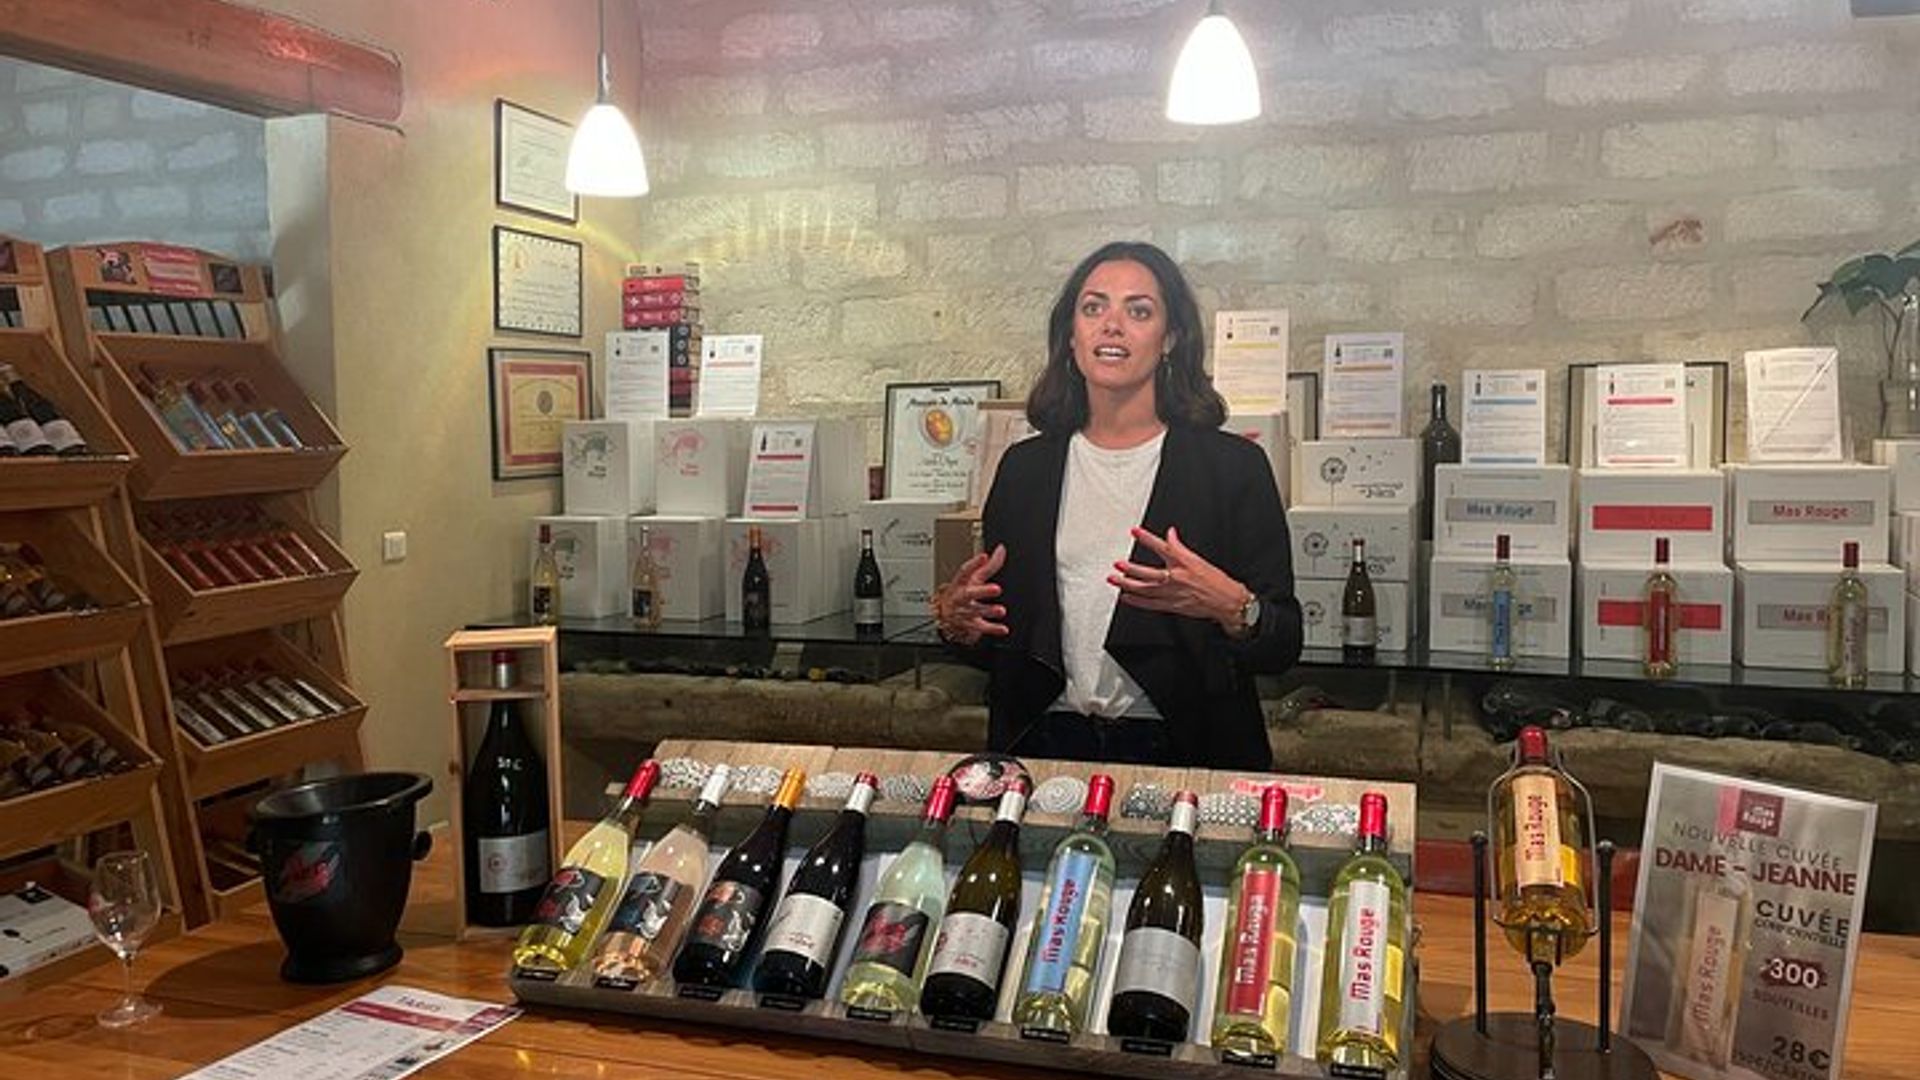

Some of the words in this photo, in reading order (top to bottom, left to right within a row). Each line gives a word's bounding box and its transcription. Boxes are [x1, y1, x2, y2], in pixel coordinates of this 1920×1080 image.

[1773, 505, 1801, 517] Mas
[1805, 505, 1849, 520] Rouge
[1673, 821, 1769, 856] NOUVELLE
[1776, 842, 1842, 871] CUVÉE
[1655, 847, 1727, 877] DAME
[1753, 862, 1857, 896] JEANNE
[1050, 877, 1079, 926] Rouge
[1239, 894, 1268, 946] Rouge
[1756, 900, 1849, 938] CUVÉE
[1041, 926, 1065, 963] Mas
[1352, 907, 1380, 959] Rouge
[1235, 946, 1259, 984] Mas
[1350, 962, 1372, 1000] Mas
[1770, 958, 1819, 989] 300
[1772, 1036, 1831, 1070] 28€
